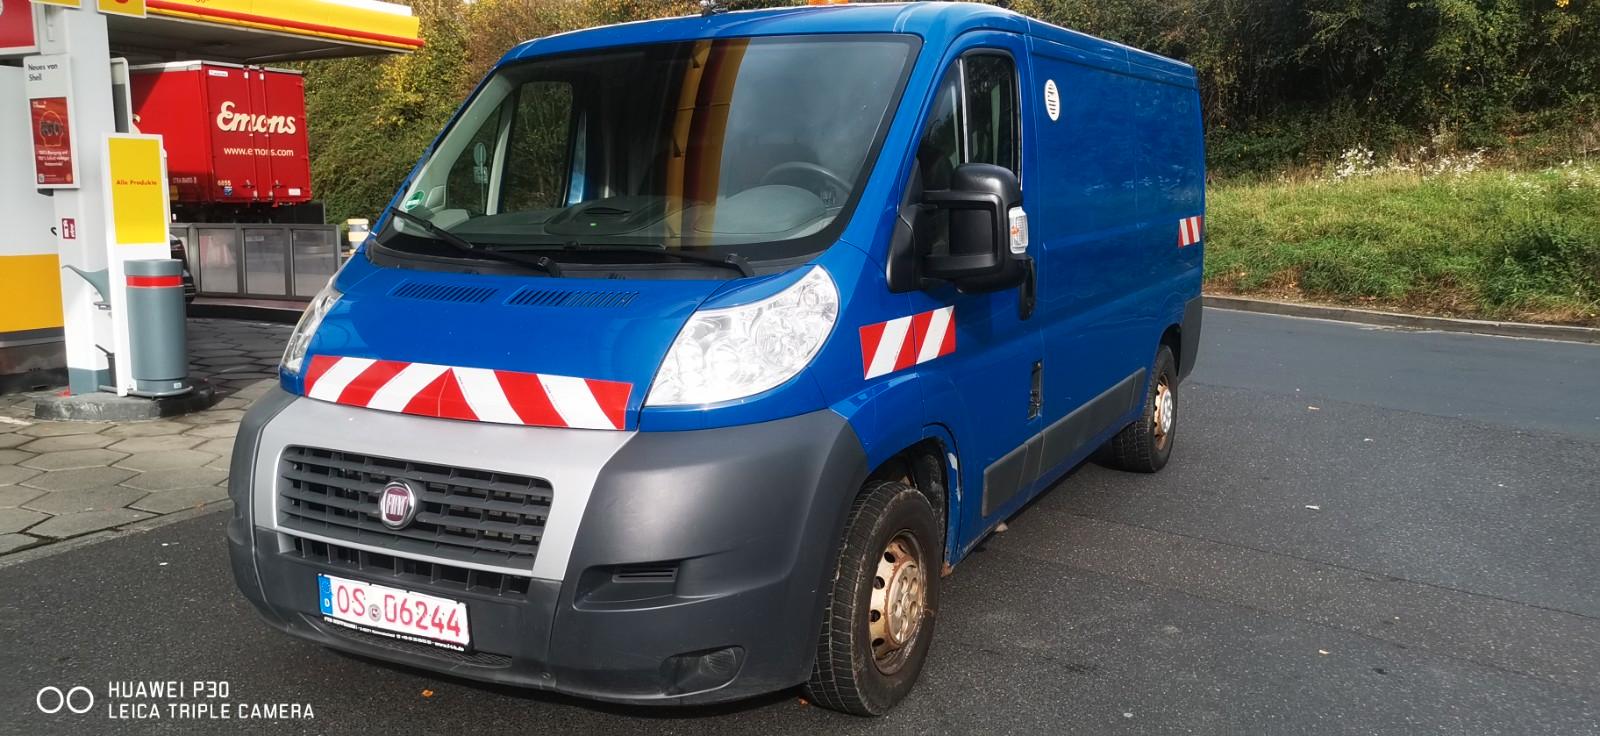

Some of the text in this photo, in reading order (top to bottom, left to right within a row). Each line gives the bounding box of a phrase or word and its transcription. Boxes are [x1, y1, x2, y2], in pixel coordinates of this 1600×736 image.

[27, 63, 46, 71] Neues
[28, 73, 42, 82] Shell
[216, 101, 296, 135] Emons
[337, 585, 365, 617] OS
